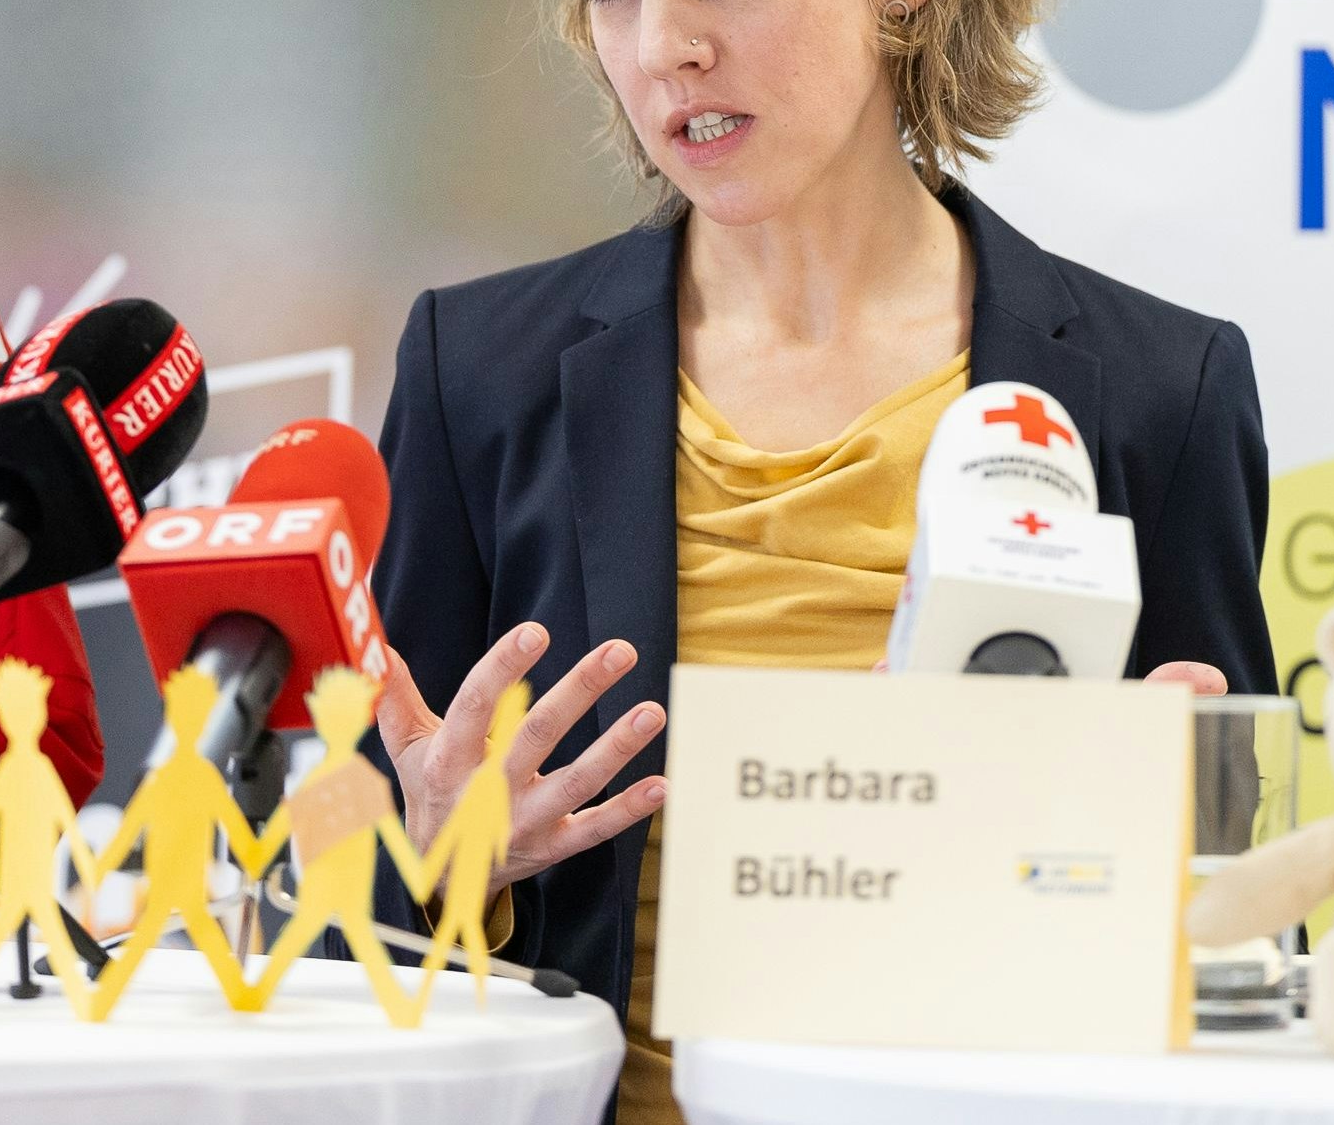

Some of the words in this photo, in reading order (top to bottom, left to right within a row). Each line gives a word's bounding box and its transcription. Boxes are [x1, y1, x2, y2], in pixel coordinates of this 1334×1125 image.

[113, 328, 204, 440] KURIER
[143, 507, 325, 551] ORF
[737, 758, 938, 804] Barbara
[733, 855, 900, 901] Bühler
